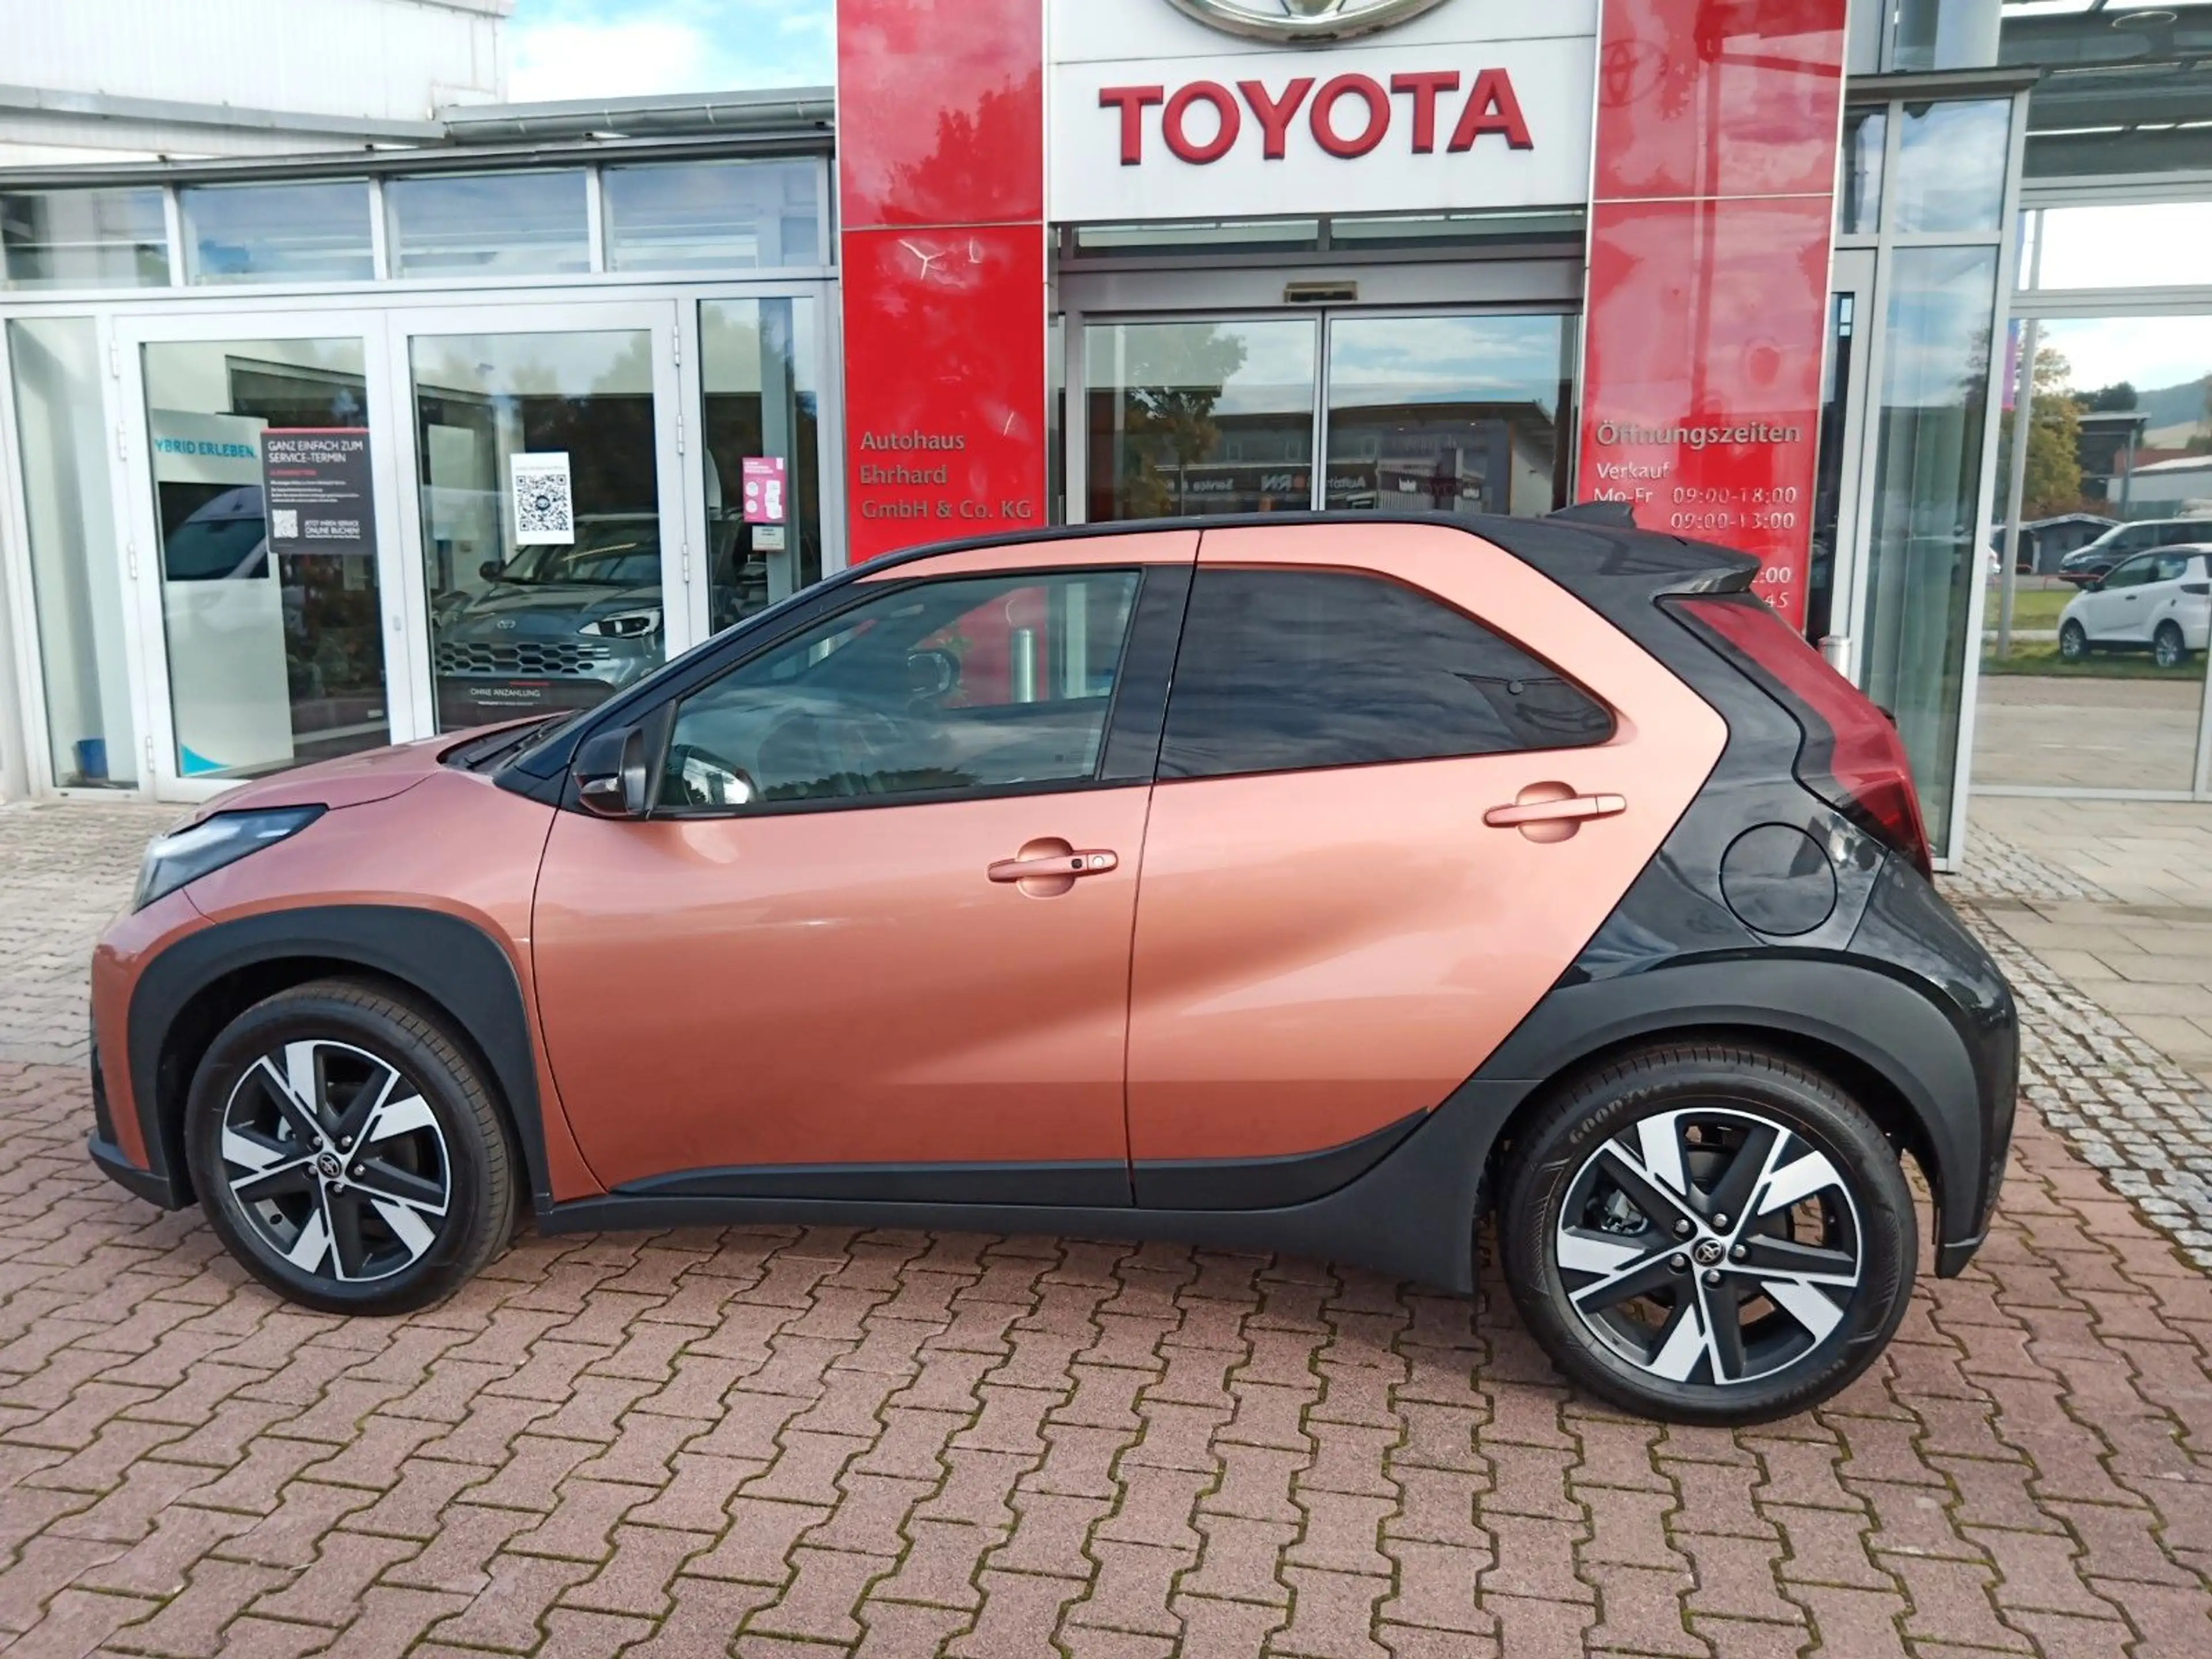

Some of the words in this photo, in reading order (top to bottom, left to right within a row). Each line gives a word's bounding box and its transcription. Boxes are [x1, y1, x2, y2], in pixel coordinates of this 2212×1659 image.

[1099, 68, 1533, 165] TOYOTA
[860, 430, 965, 450] Autohaus
[1597, 421, 1802, 449] Öffnungszeiten
[268, 440, 296, 451] GANZ
[297, 440, 339, 451] EINFACH
[341, 440, 363, 451] ZUM
[268, 452, 346, 463] SERVICE-TERMIN
[860, 464, 948, 485] Ehrhard
[1597, 462, 1671, 480] Verkauf
[1593, 487, 1653, 503] Mo-Fr
[1673, 486, 1797, 506] 09:00-18:00
[862, 500, 928, 518] GmbH
[936, 501, 952, 518] &
[960, 500, 994, 518] Co.
[1001, 500, 1032, 518] KG
[1671, 511, 1795, 529] 09:00-13:00
[1752, 566, 1791, 584] :00
